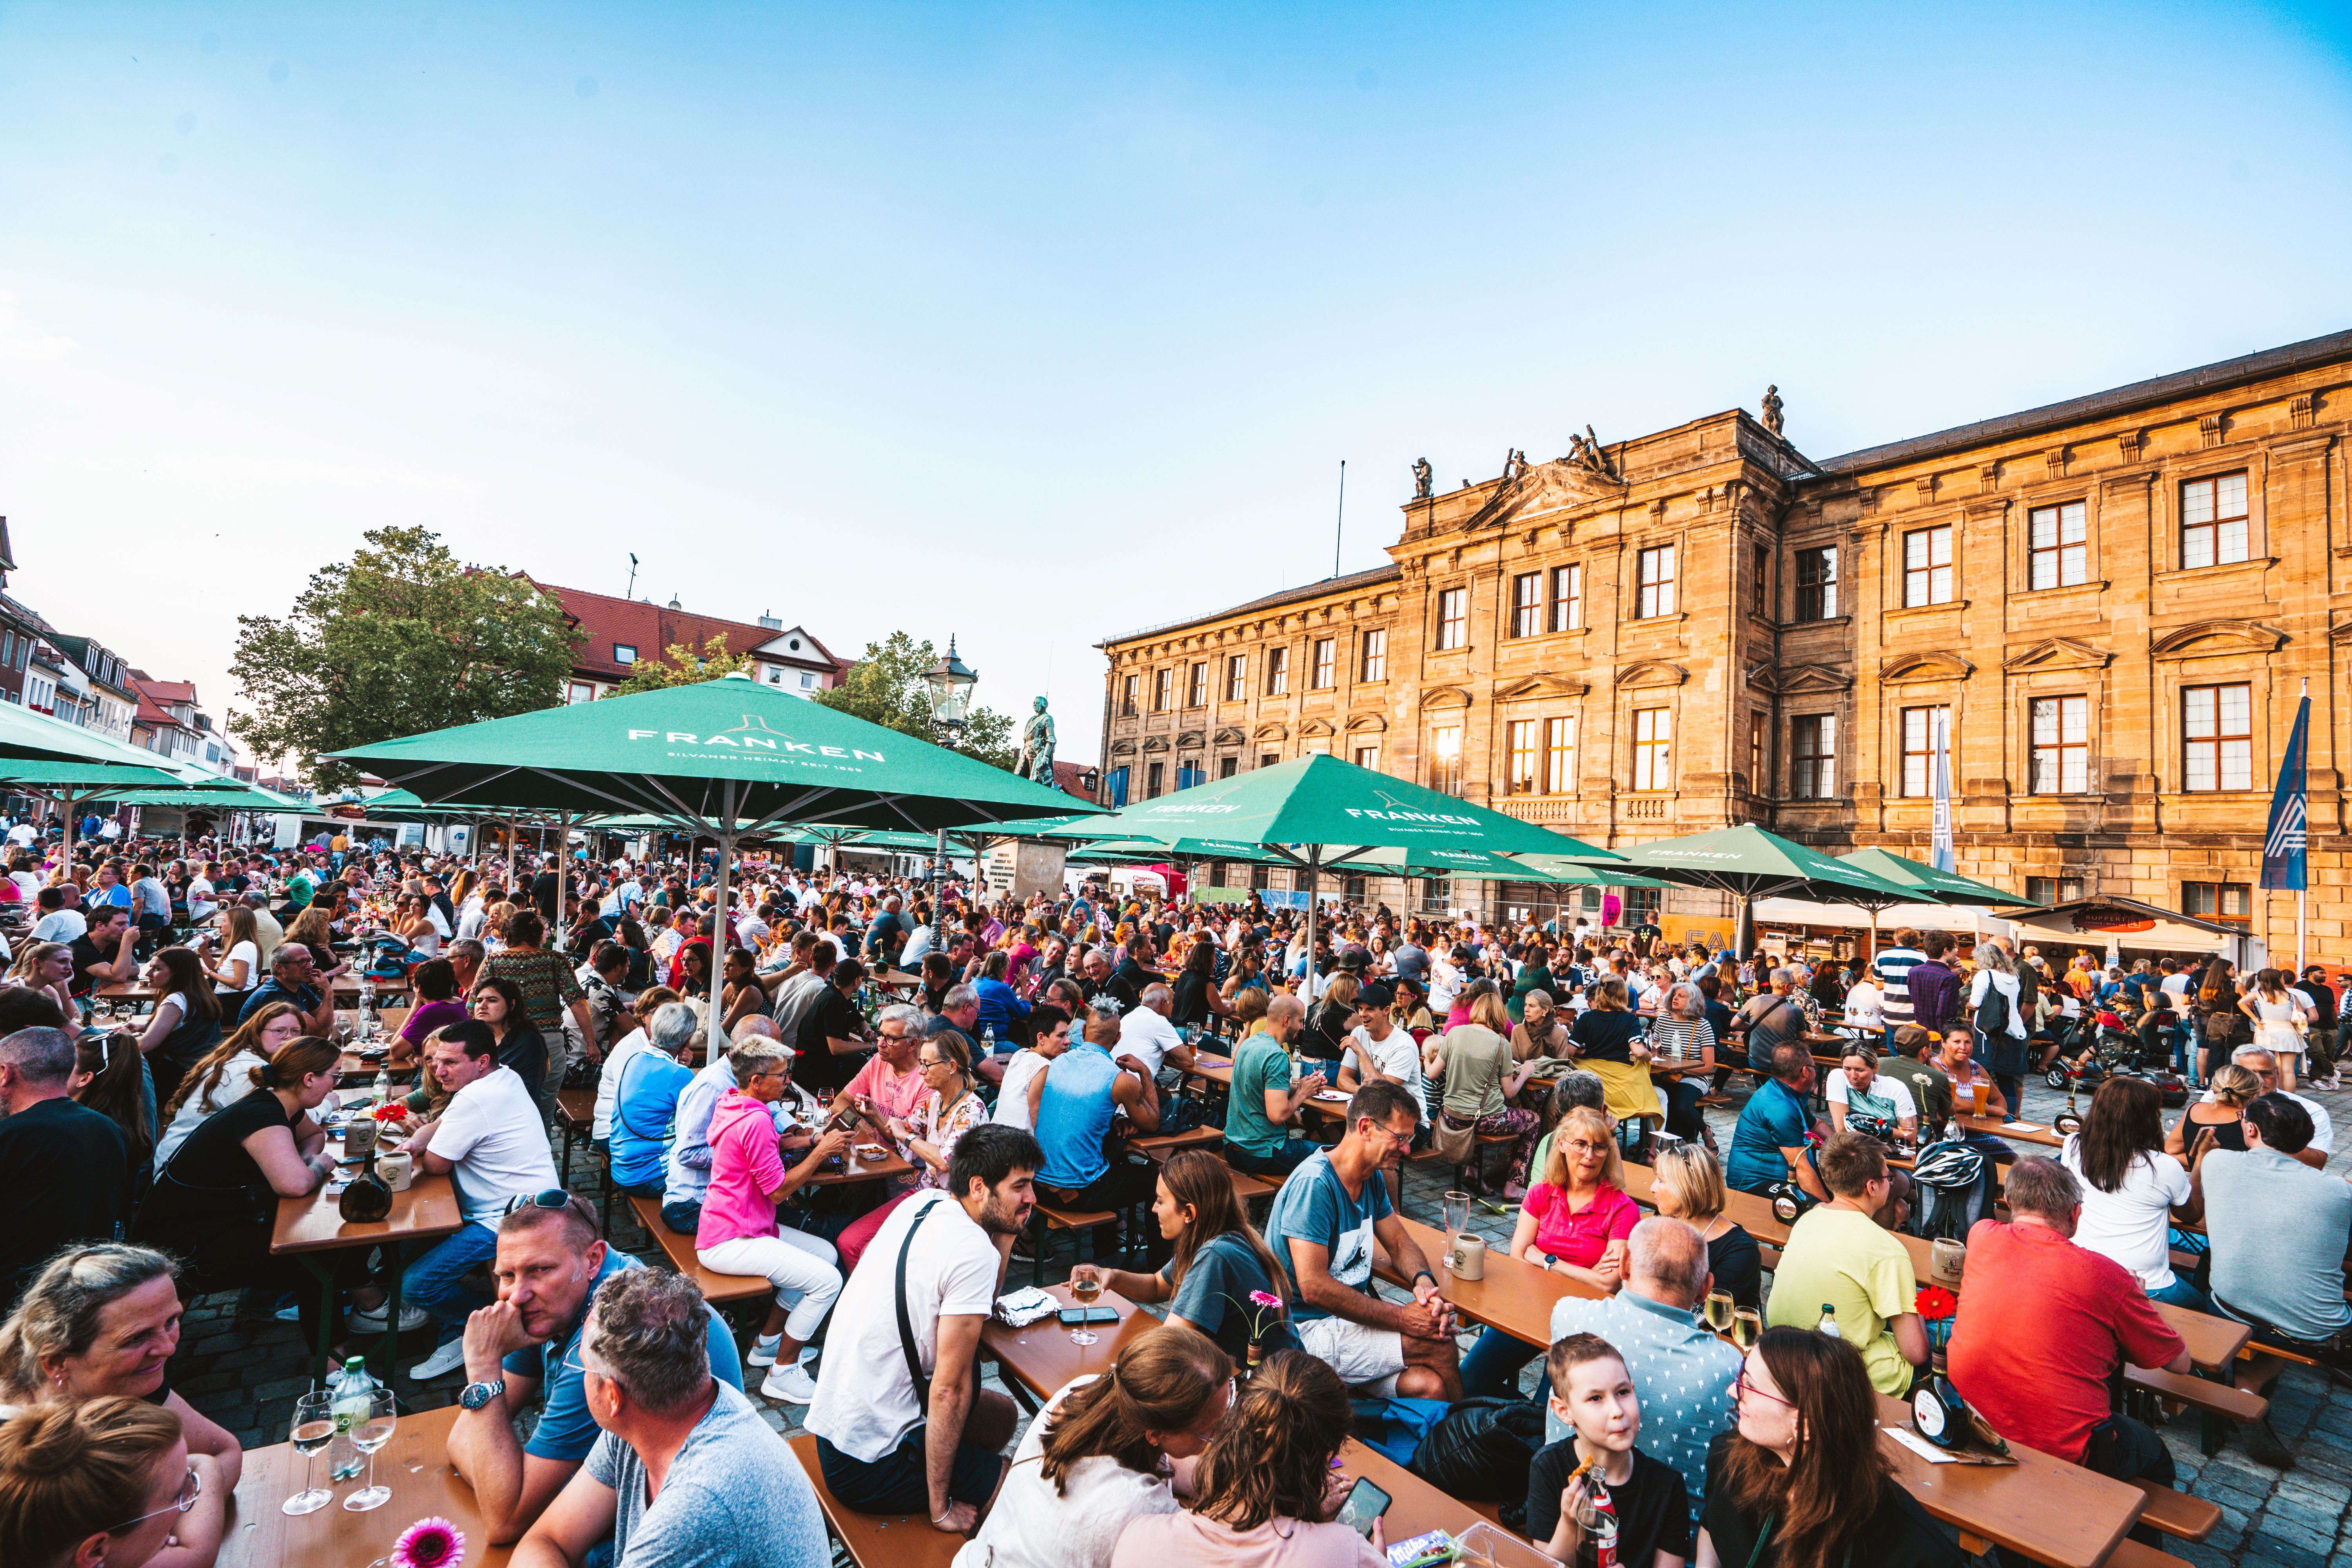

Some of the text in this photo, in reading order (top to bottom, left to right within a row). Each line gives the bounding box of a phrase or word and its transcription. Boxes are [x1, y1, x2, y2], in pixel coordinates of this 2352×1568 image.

[629, 730, 886, 762] FRANKEN
[667, 752, 738, 760] SILVANER
[744, 757, 795, 765] HEIMAT
[1147, 804, 1241, 813] FRANKEN
[1345, 808, 1481, 826] FRANKEN
[1200, 842, 1250, 851] FRANKEN
[1431, 851, 1490, 861] FRANKEN
[1647, 850, 1743, 859] FRANKEN
[1387, 1538, 1429, 1564] Milka
